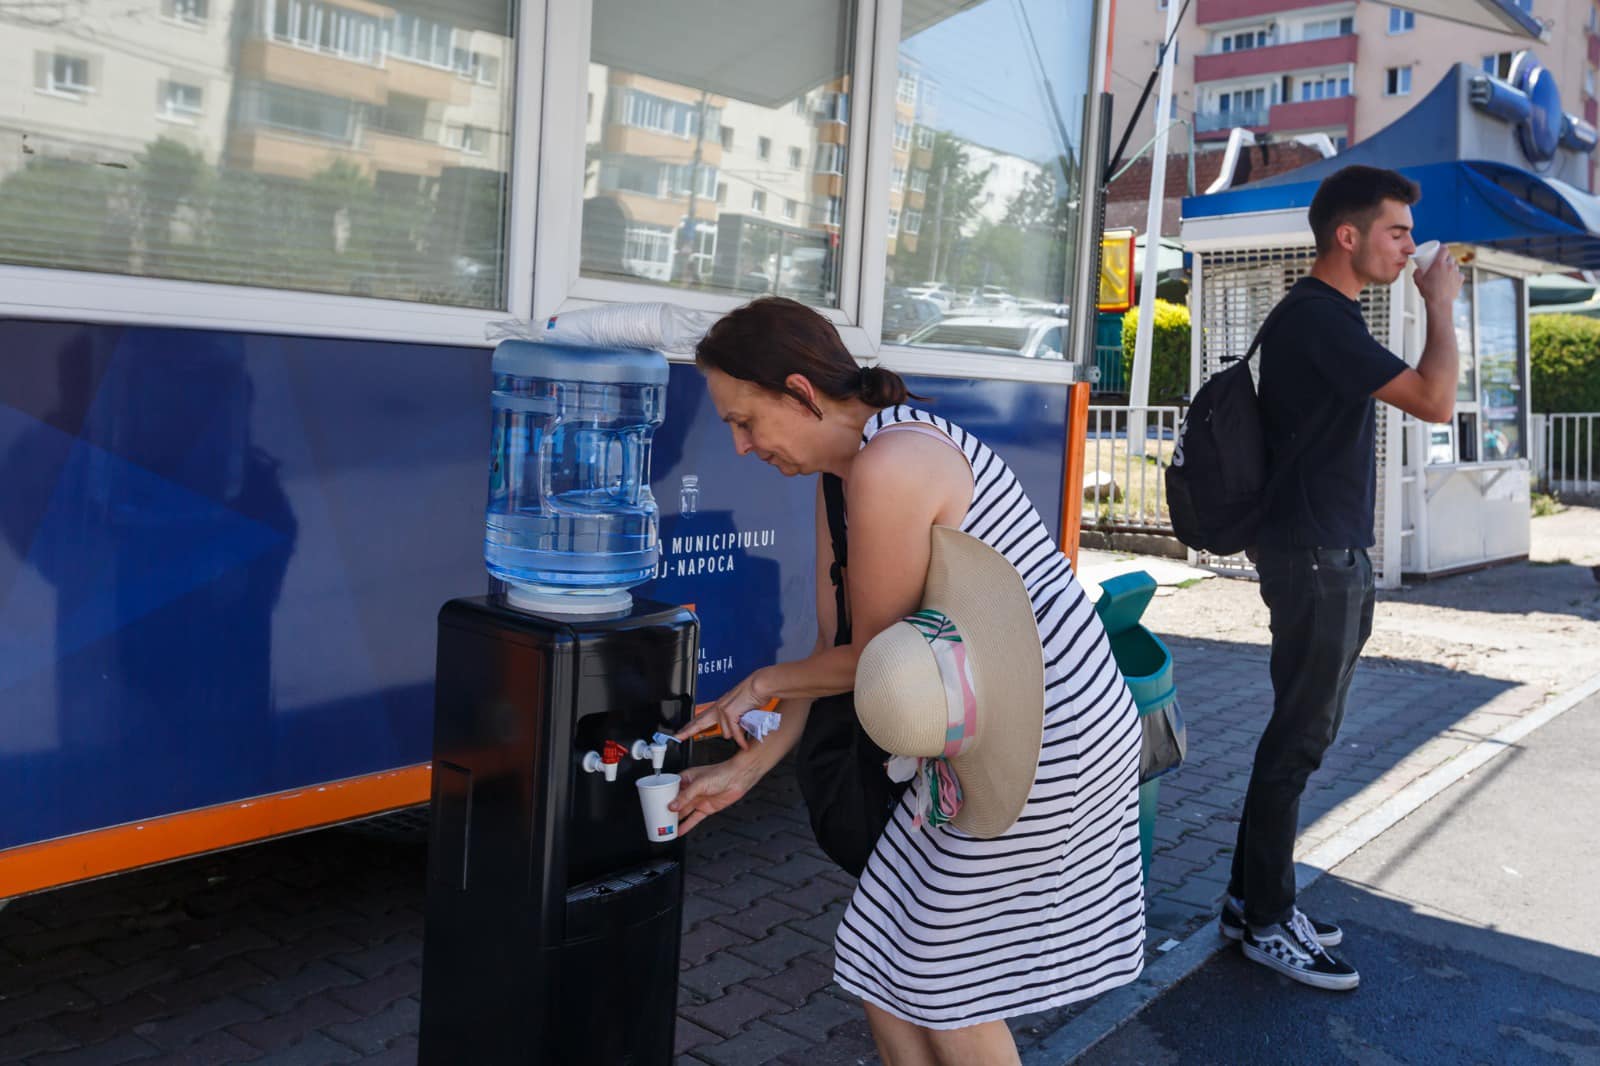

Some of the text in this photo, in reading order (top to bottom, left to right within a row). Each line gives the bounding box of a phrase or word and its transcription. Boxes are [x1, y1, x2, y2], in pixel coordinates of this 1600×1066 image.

[657, 529, 775, 555] A MUNICIPIULUI
[651, 555, 735, 579] UJ-NAPOCA
[697, 656, 734, 675] RGENȚĂ
